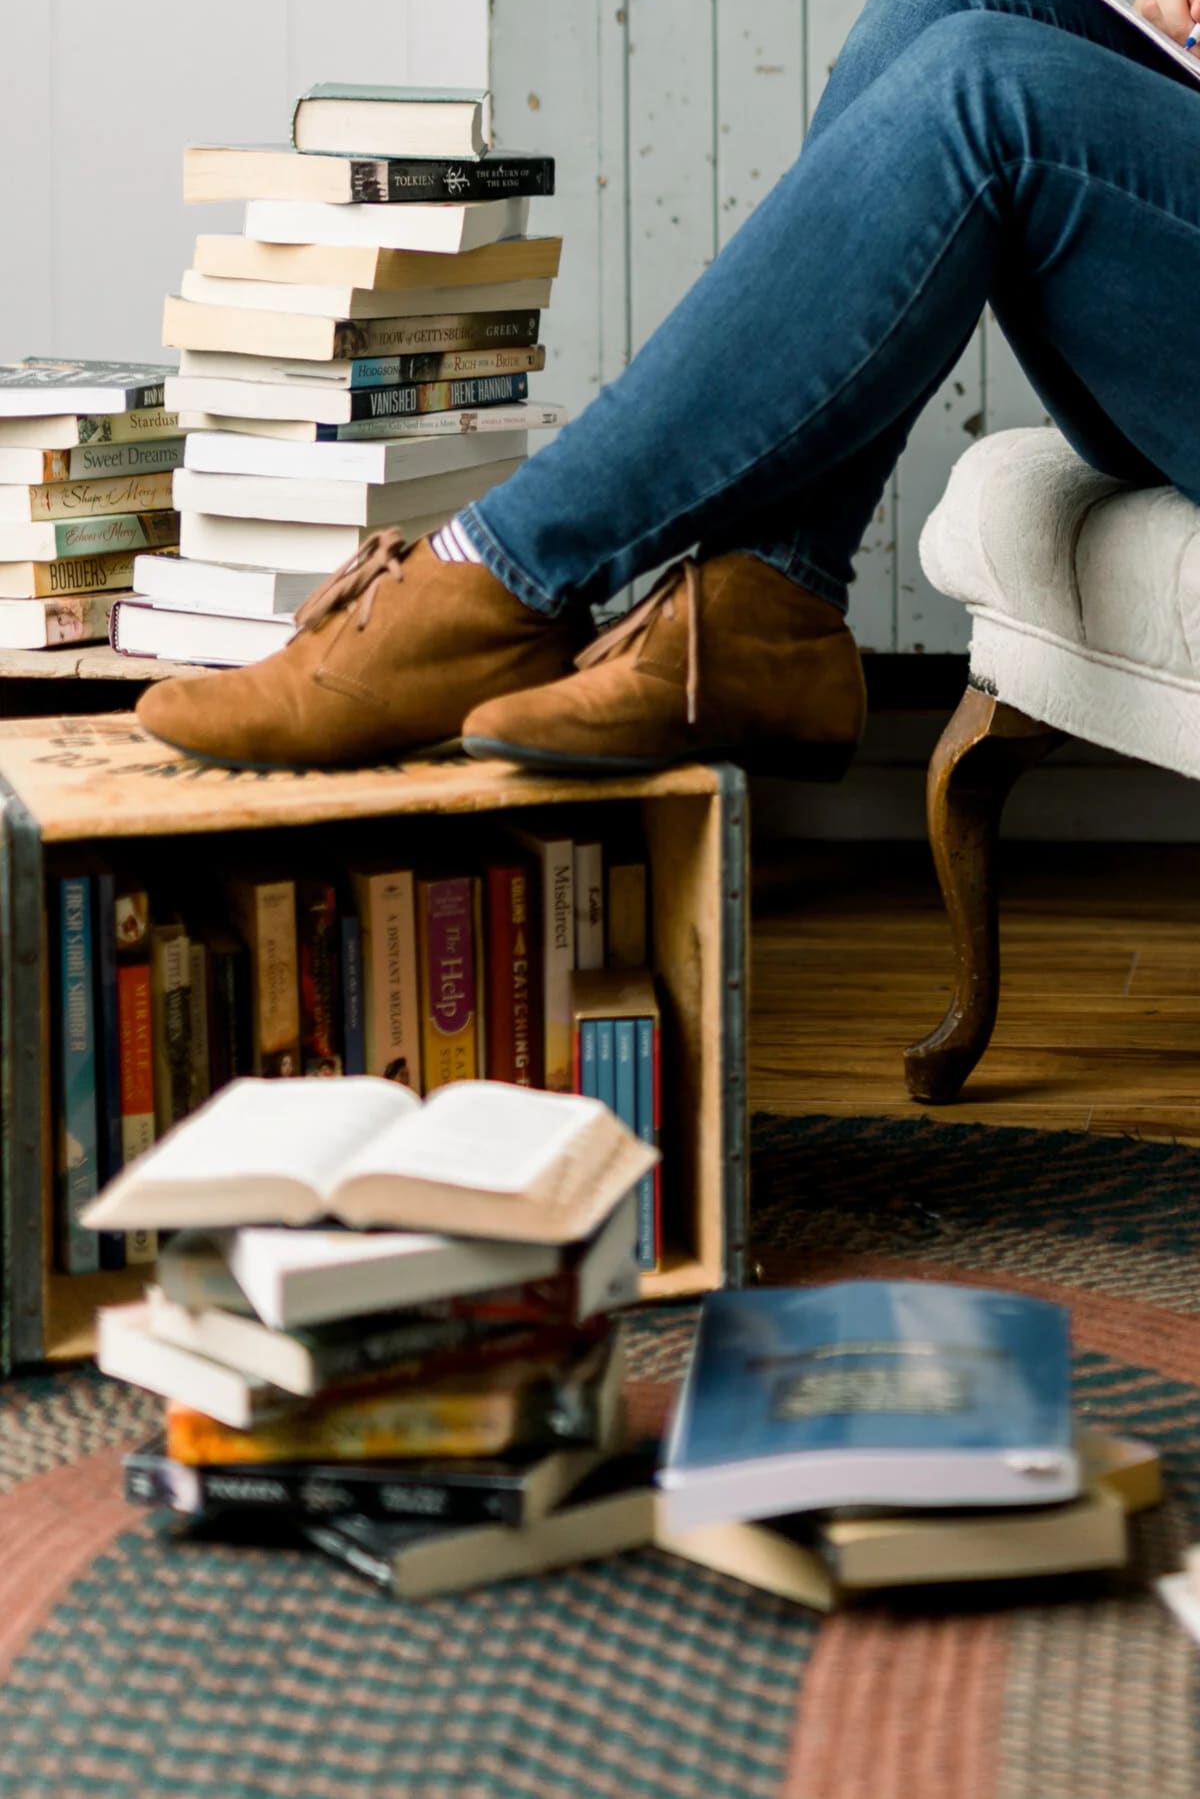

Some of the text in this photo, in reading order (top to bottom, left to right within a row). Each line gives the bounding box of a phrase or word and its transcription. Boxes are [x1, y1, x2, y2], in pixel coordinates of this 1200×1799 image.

[394, 174, 435, 187] TOLKIEN
[476, 168, 530, 178] THE RETURN OF
[487, 178, 520, 187] THE KING
[486, 323, 519, 337] GREEN
[358, 362, 401, 378] HODGSON
[454, 355, 477, 371] RICH
[495, 353, 521, 369] BRIDE
[370, 388, 417, 416] VANISHED
[451, 375, 513, 406] IRENE HANNON
[130, 411, 179, 429] Stardust
[83, 447, 178, 469] Sweet Dreams
[62, 484, 102, 510] Shape
[110, 479, 158, 508] Mercy
[65, 523, 96, 546] Echoes
[103, 522, 138, 543] Mercy
[50, 558, 107, 591] BORDERS
[554, 865, 570, 950] Misdirect
[445, 925, 460, 954] The
[66, 884, 86, 1052] FRESH START SUMMER
[387, 912, 403, 1048] A DISTANT MELODY
[434, 957, 465, 1018] Help
[133, 983, 149, 1071] MIRACLE
[167, 990, 184, 1042] WOMEN
[513, 960, 529, 1068] CATCHING
